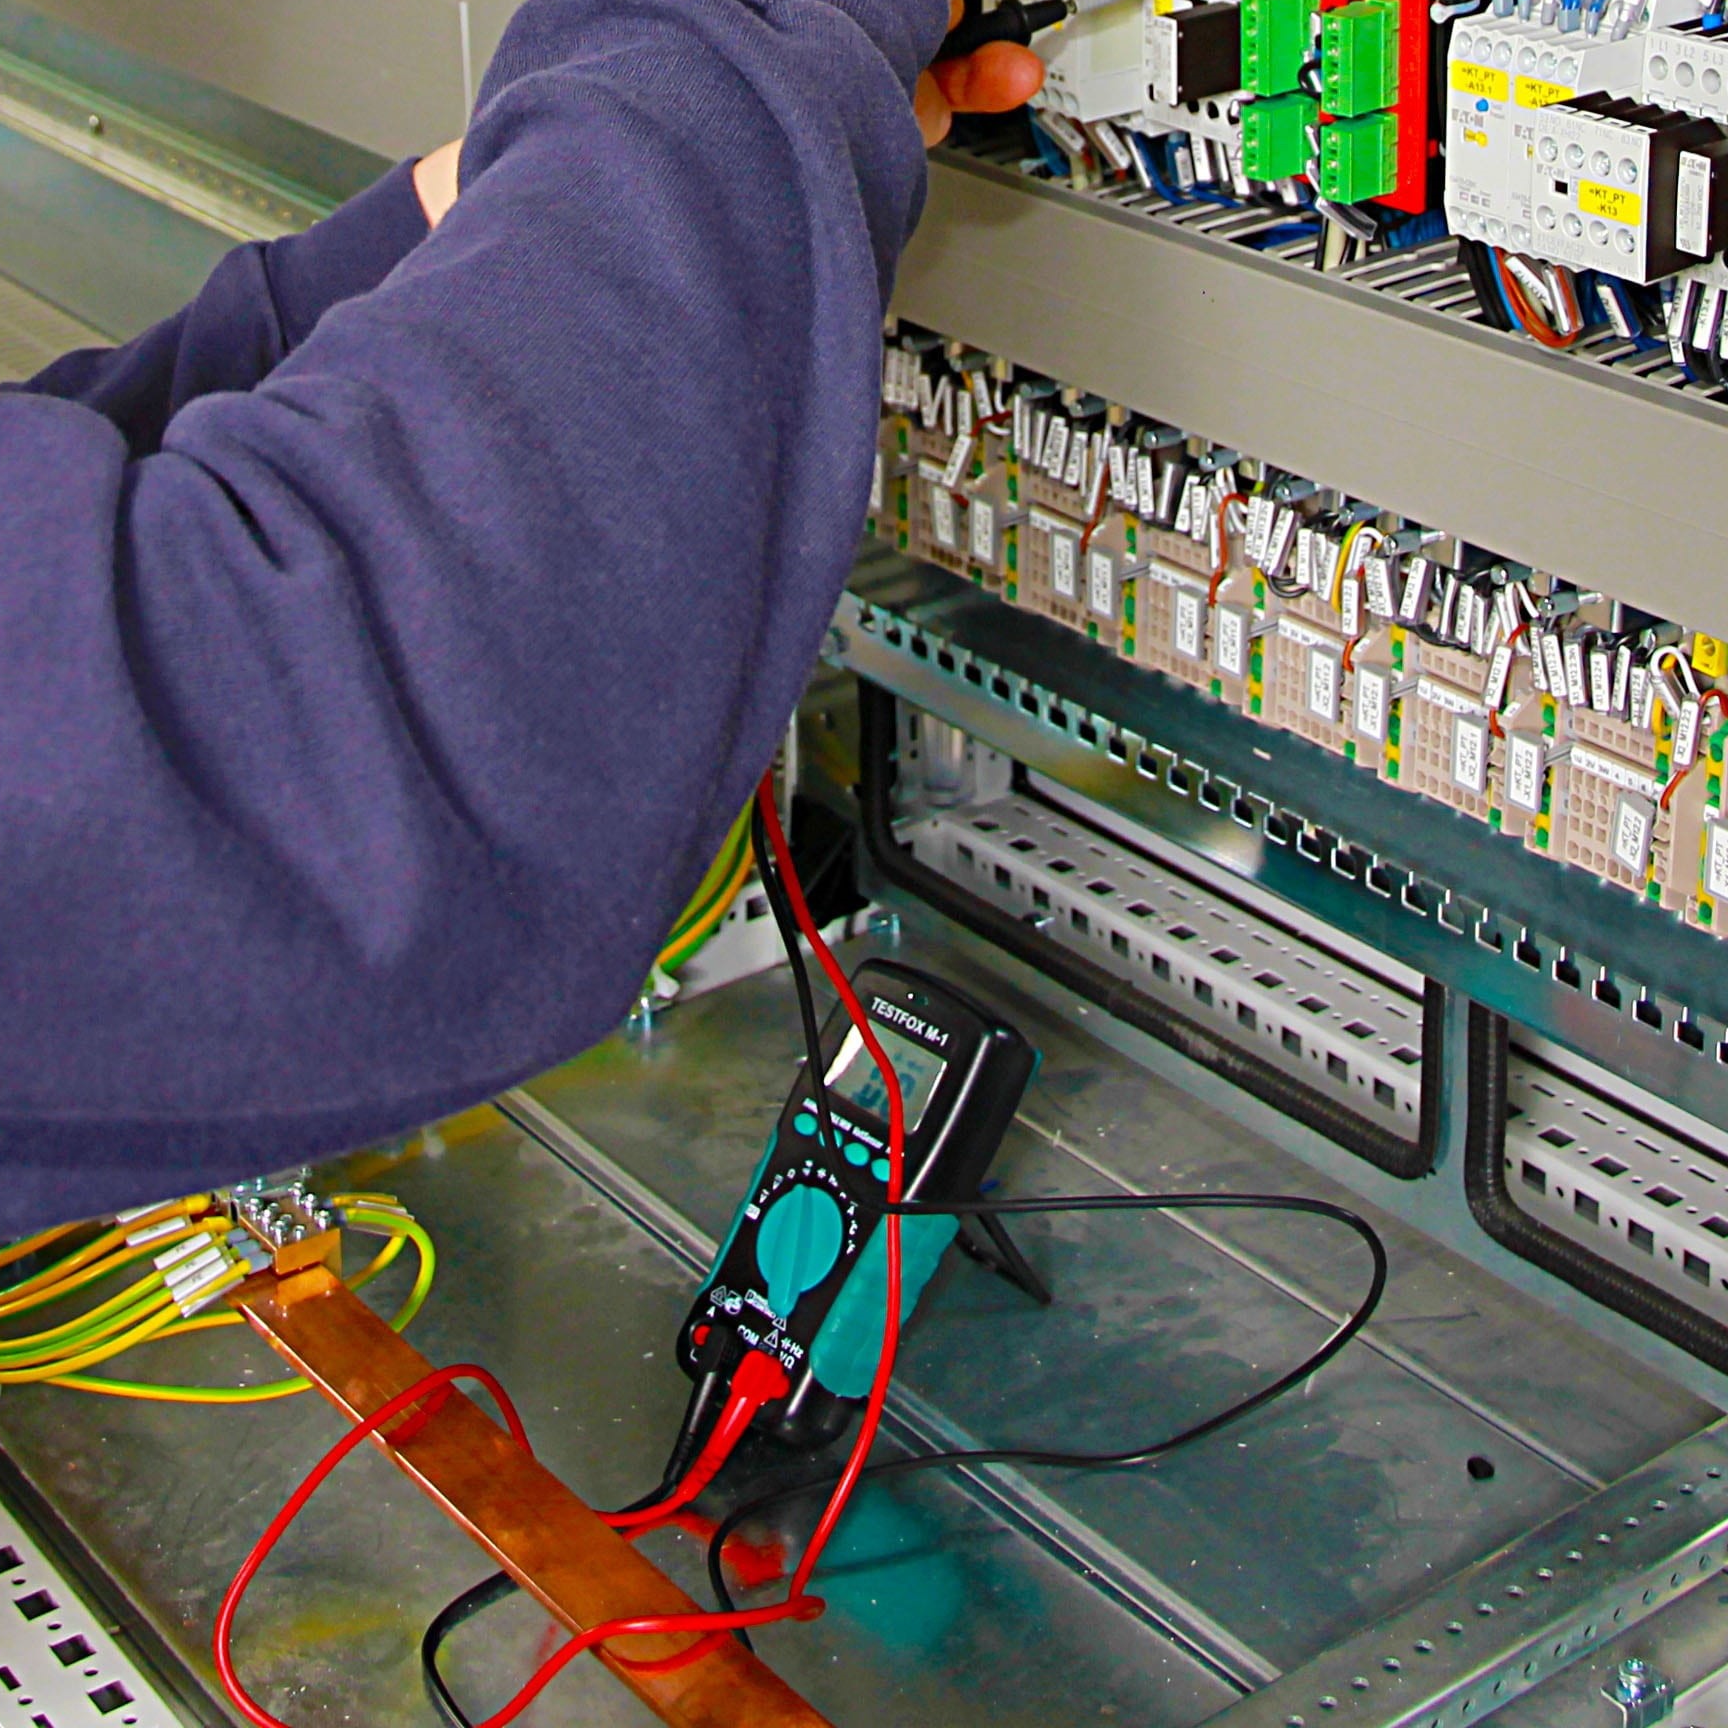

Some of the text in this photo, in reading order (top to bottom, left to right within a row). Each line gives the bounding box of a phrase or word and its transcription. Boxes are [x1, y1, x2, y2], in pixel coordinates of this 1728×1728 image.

[1460, 66, 1496, 82] =KT_PT
[1588, 187, 1626, 205] =KT_PT
[1596, 202, 1618, 217] -K13
[872, 996, 950, 1047] TESTFOX M-1
[737, 1324, 760, 1345] COM
